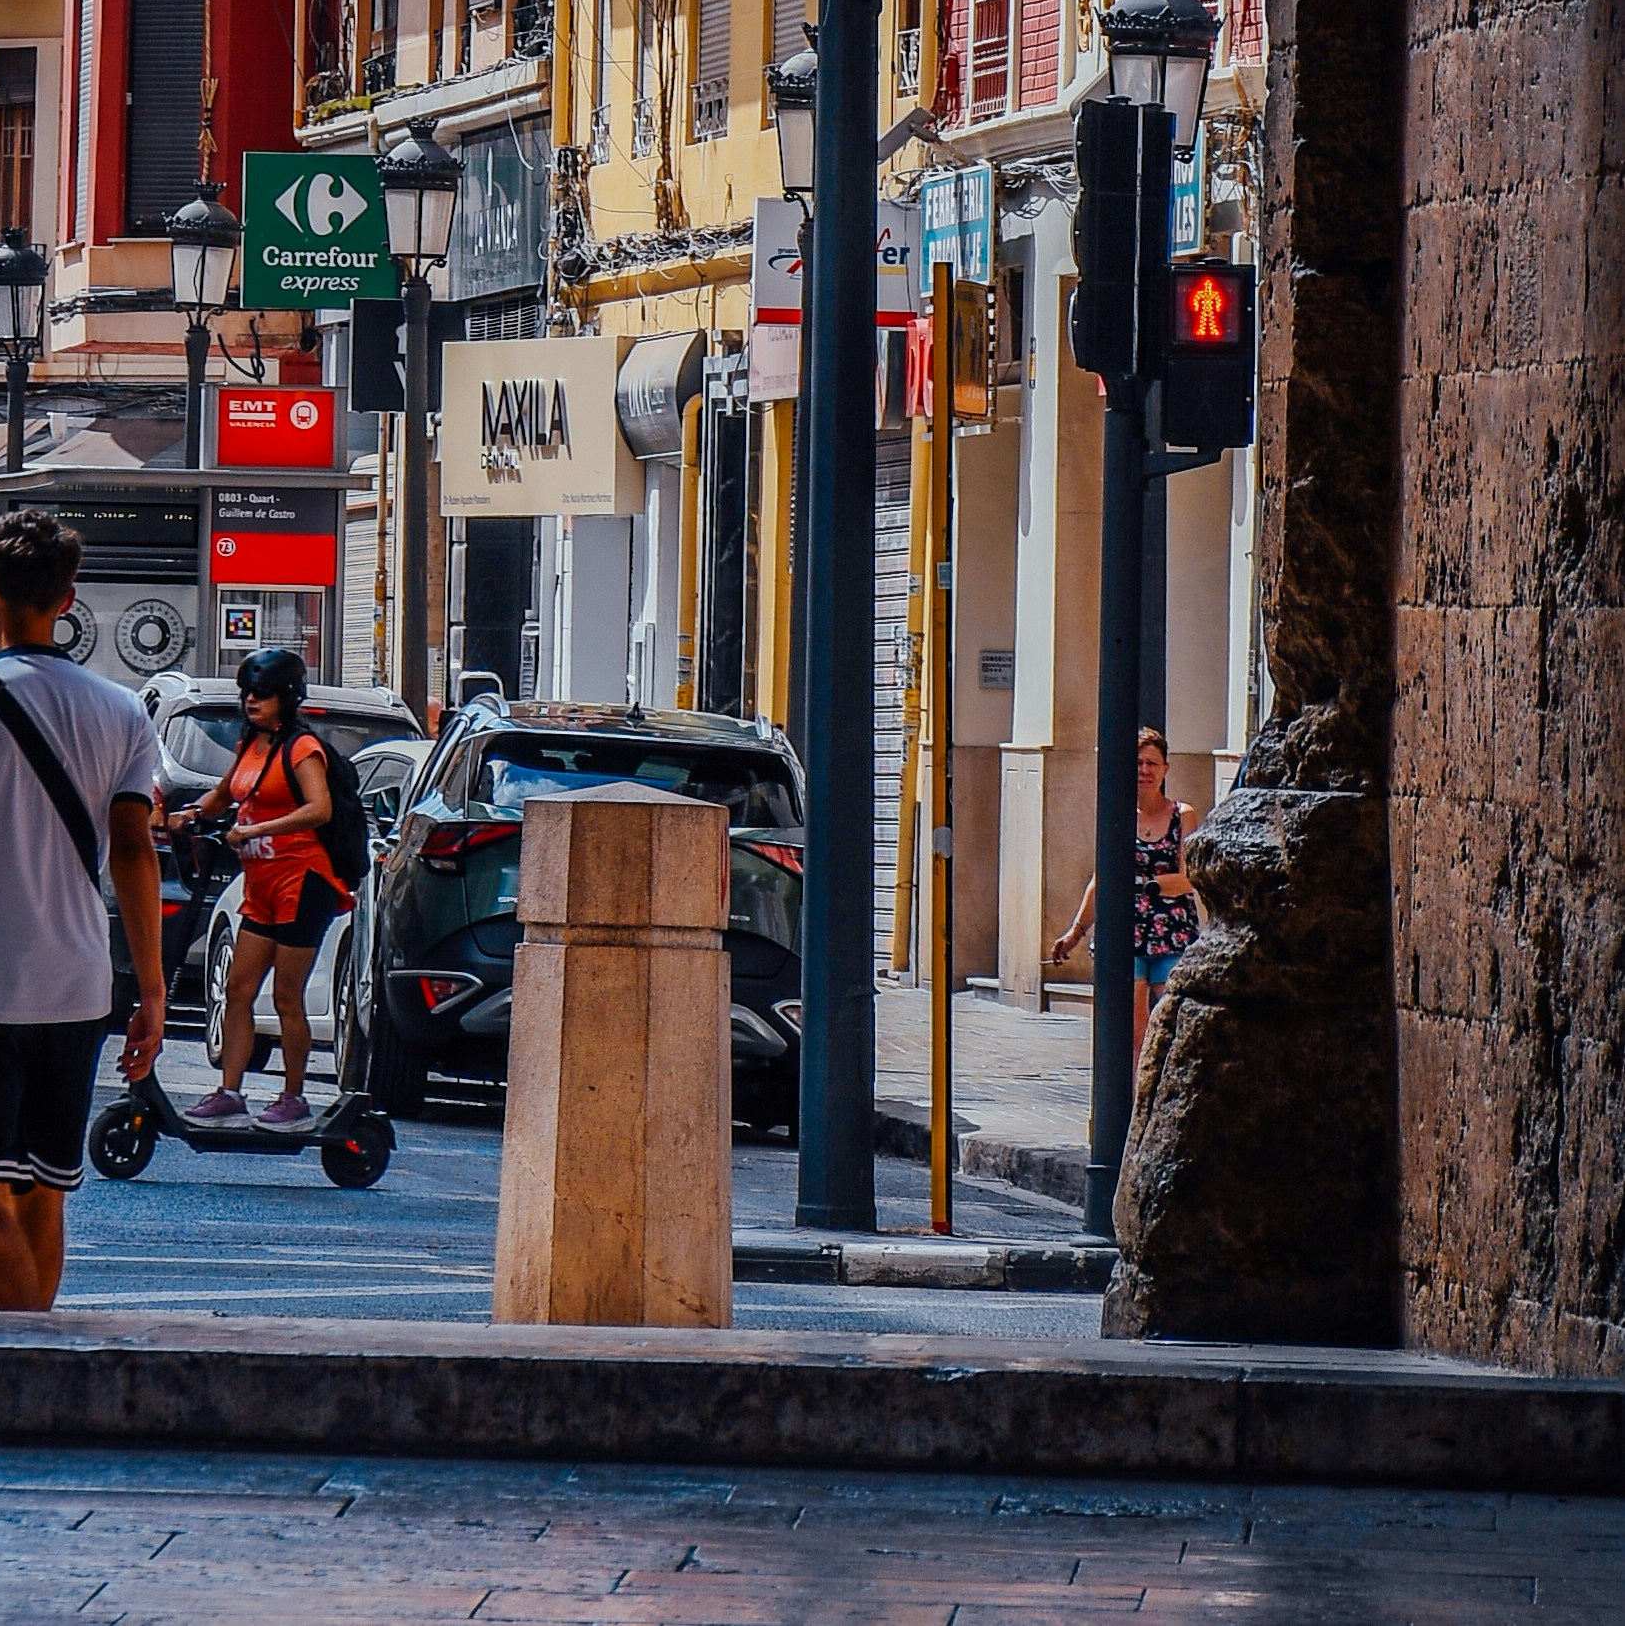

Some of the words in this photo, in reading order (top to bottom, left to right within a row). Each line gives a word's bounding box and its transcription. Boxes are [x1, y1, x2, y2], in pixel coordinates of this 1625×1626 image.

[262, 245, 379, 268] Carrefour
[280, 274, 361, 298] express
[228, 400, 277, 412] EMT
[218, 493, 242, 503] 0803
[248, 493, 275, 504] Quart
[218, 507, 254, 518] Guillem
[254, 509, 267, 519] de
[268, 509, 296, 519] Castro
[219, 542, 234, 553] 73
